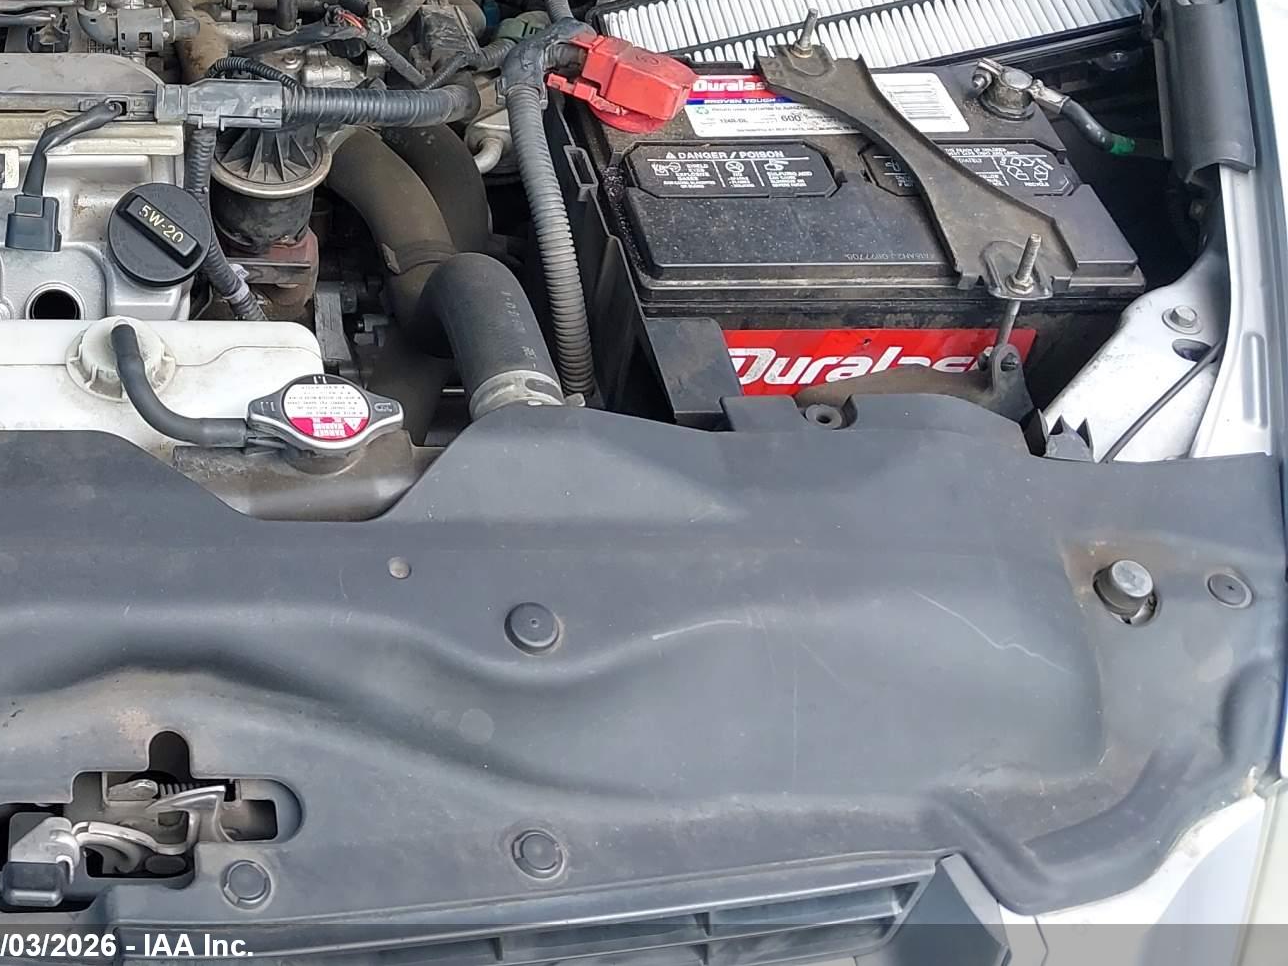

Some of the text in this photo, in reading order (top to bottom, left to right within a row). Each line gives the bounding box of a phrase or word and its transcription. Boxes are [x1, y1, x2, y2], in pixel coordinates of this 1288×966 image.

[693, 80, 767, 92] Duralas
[678, 151, 728, 159] DANGER
[738, 150, 785, 159] POISON
[138, 204, 184, 244] 5W-20
[728, 346, 993, 385] Durals
